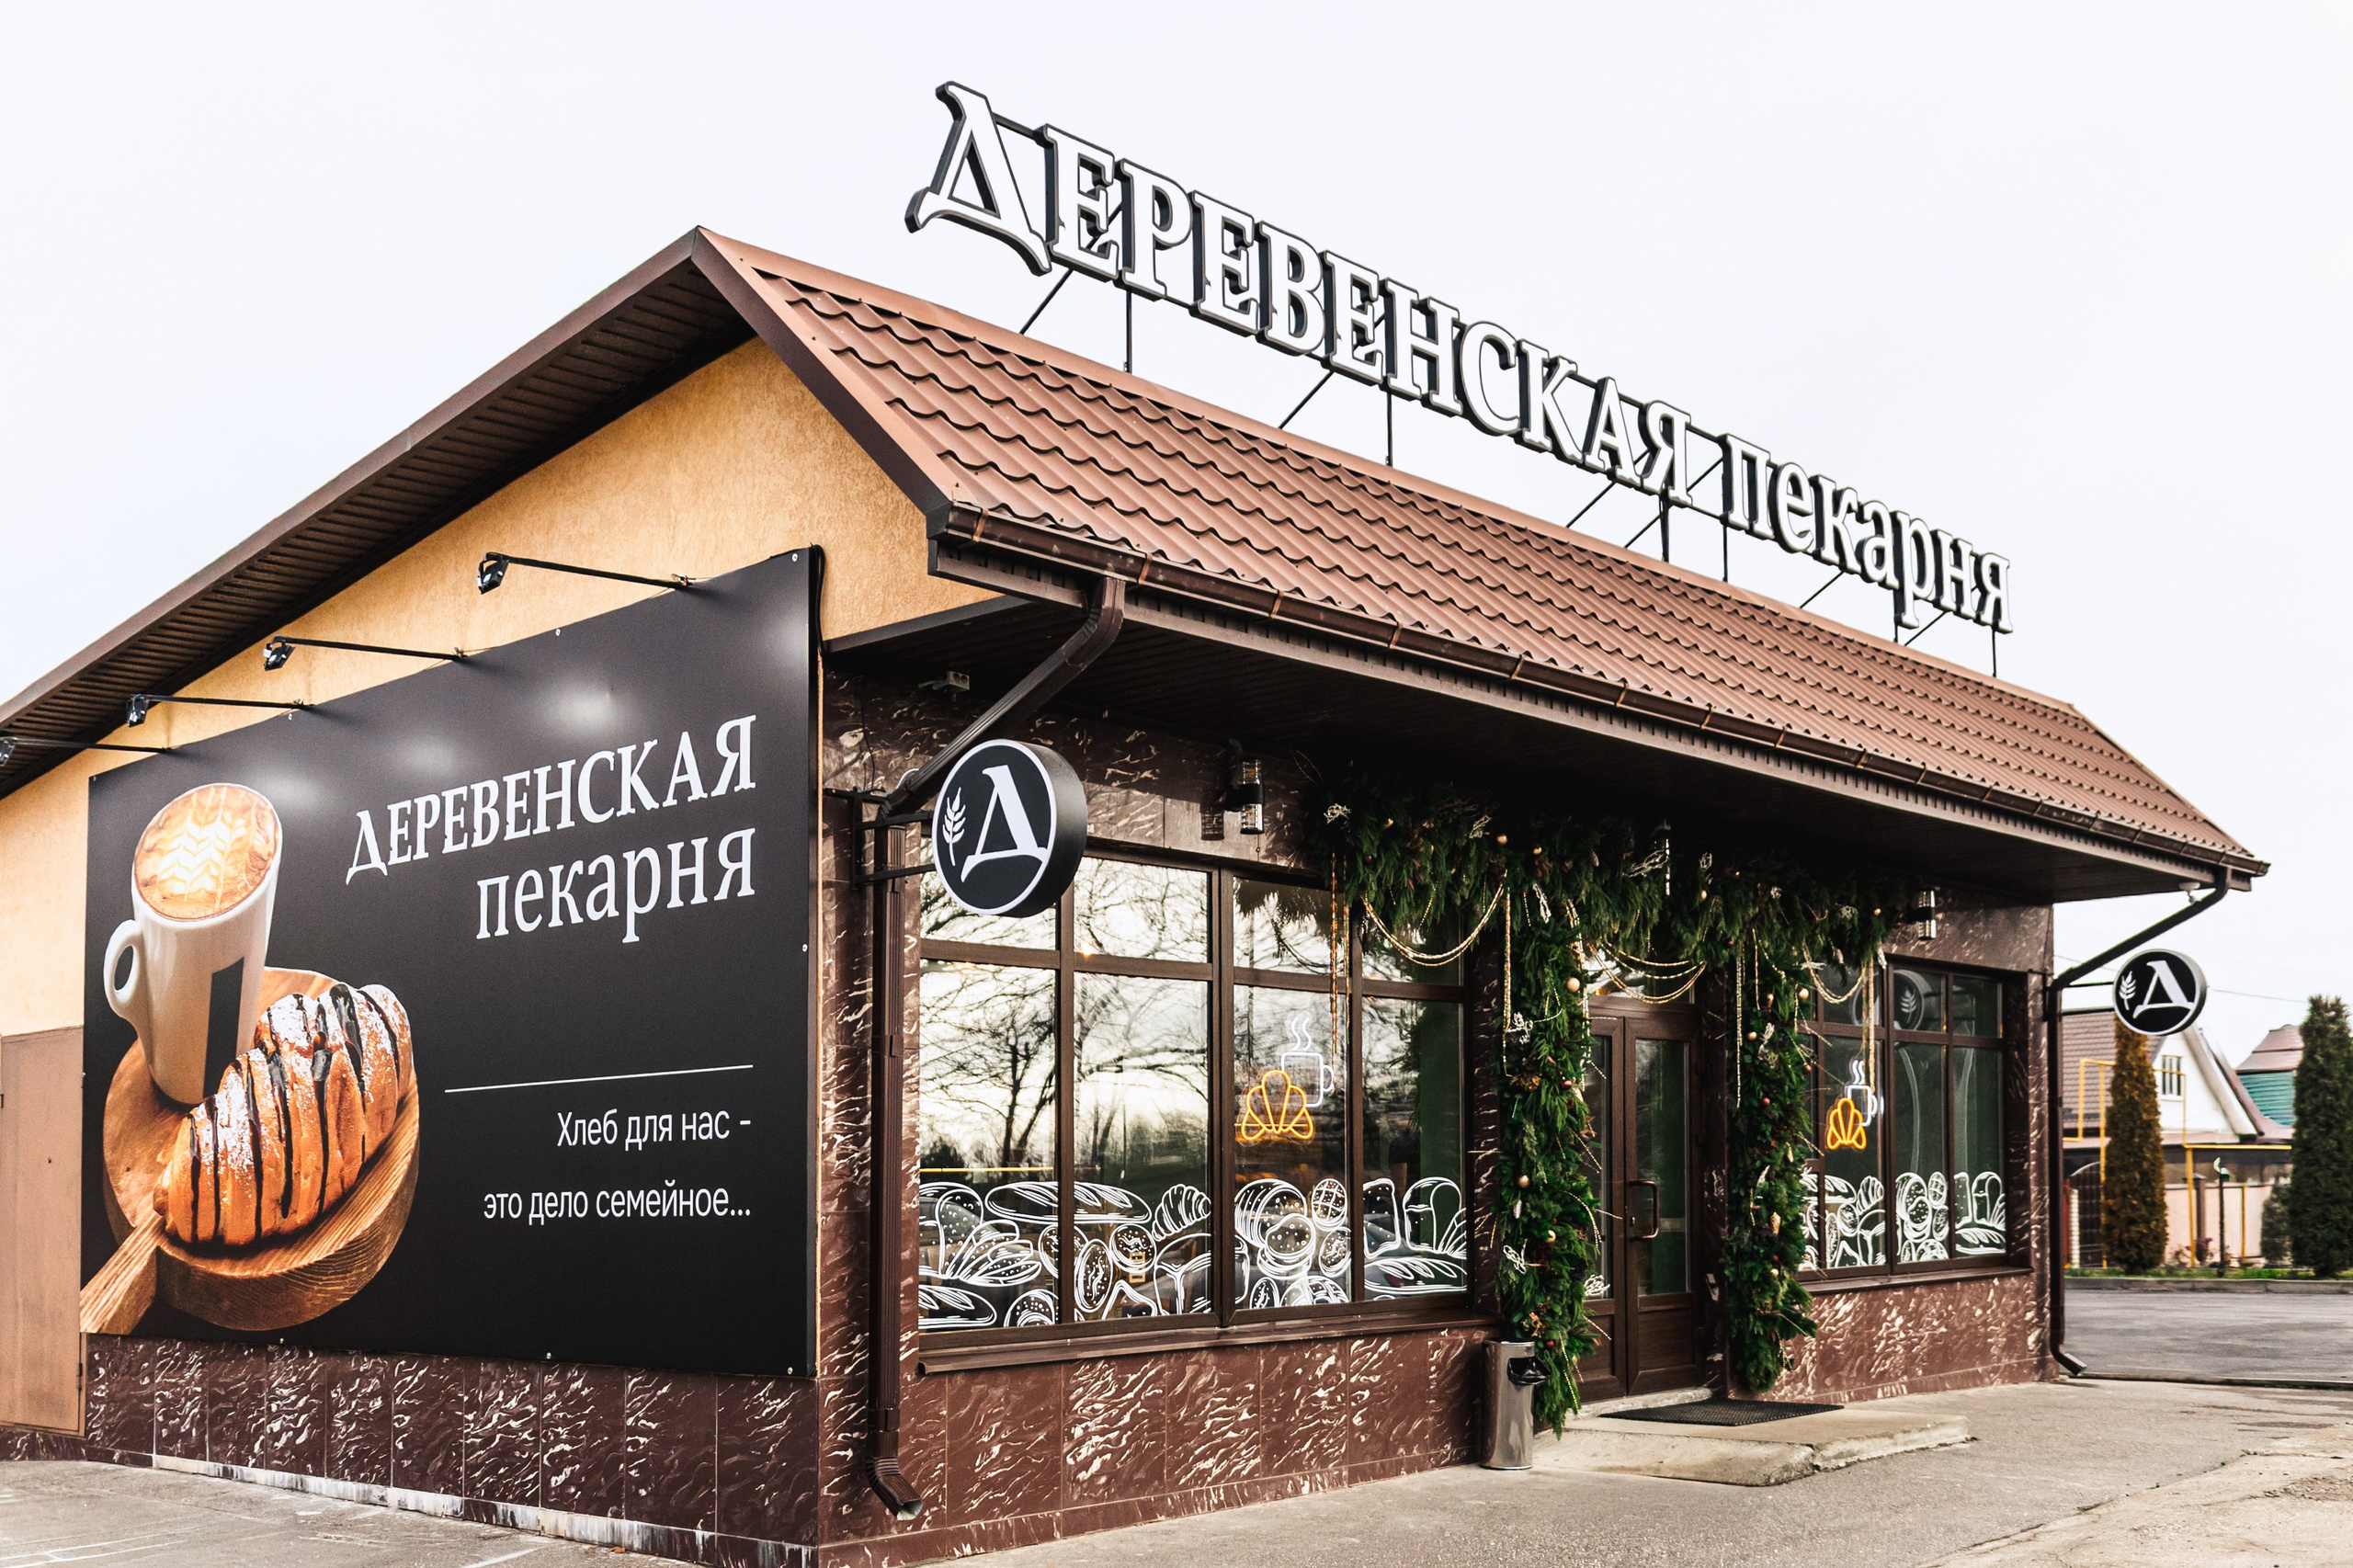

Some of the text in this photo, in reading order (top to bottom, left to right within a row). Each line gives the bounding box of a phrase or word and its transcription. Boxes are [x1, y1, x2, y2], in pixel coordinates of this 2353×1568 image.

[905, 81, 2013, 634] ДЕРЕВЕНСКАЯ пекарня
[346, 714, 756, 884] ДЕРЕВЕНСКАЯ
[961, 765, 1049, 883] Д
[476, 828, 756, 943] пекарня
[2133, 960, 2195, 1019] Д
[557, 1108, 618, 1147] Хлеб
[625, 1113, 673, 1151] для
[681, 1110, 730, 1141] нас
[483, 1179, 751, 1225] это дело семейное...
